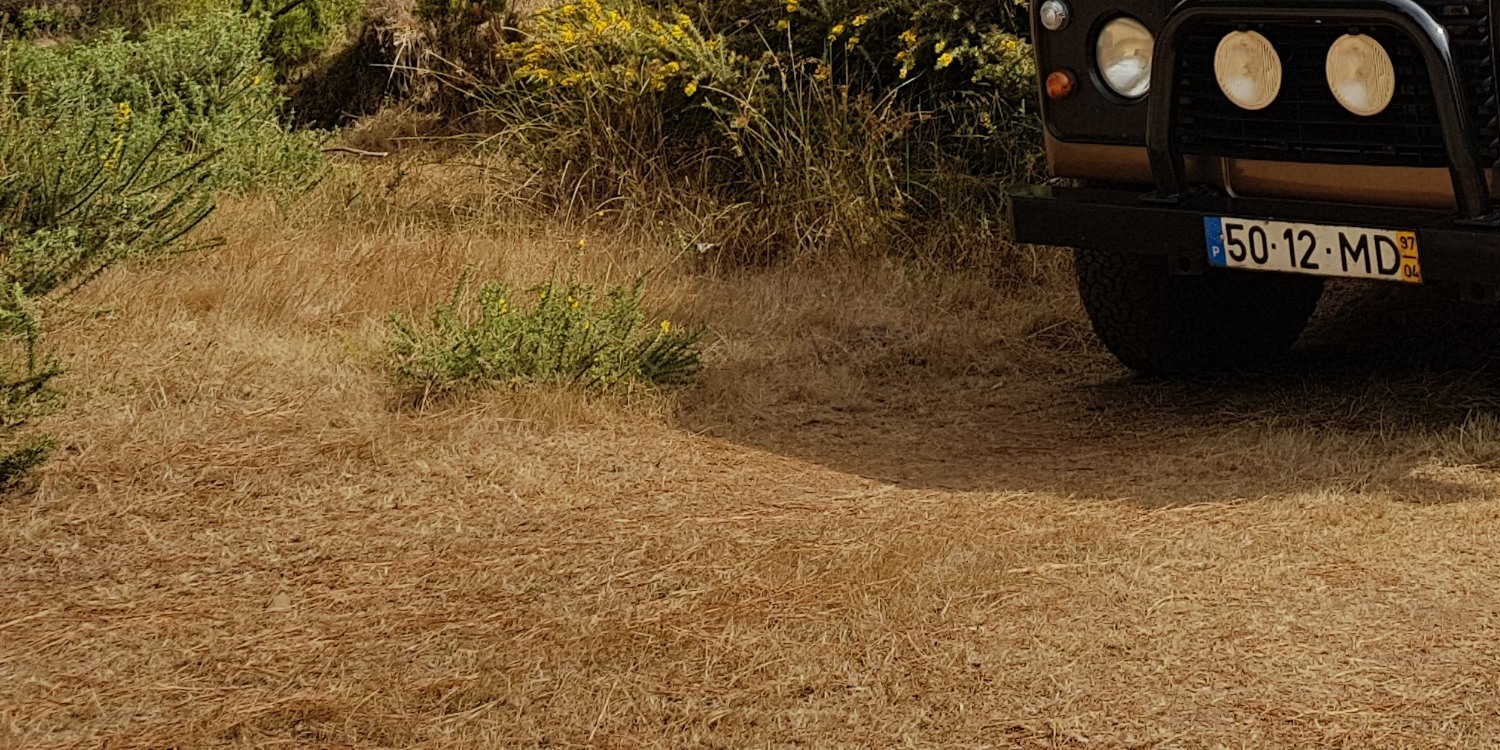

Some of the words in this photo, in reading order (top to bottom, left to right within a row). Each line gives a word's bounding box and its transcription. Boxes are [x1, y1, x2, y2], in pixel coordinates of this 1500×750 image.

[1400, 236, 1414, 250] 97
[1212, 246, 1220, 257] P
[1404, 264, 1420, 278] 04
